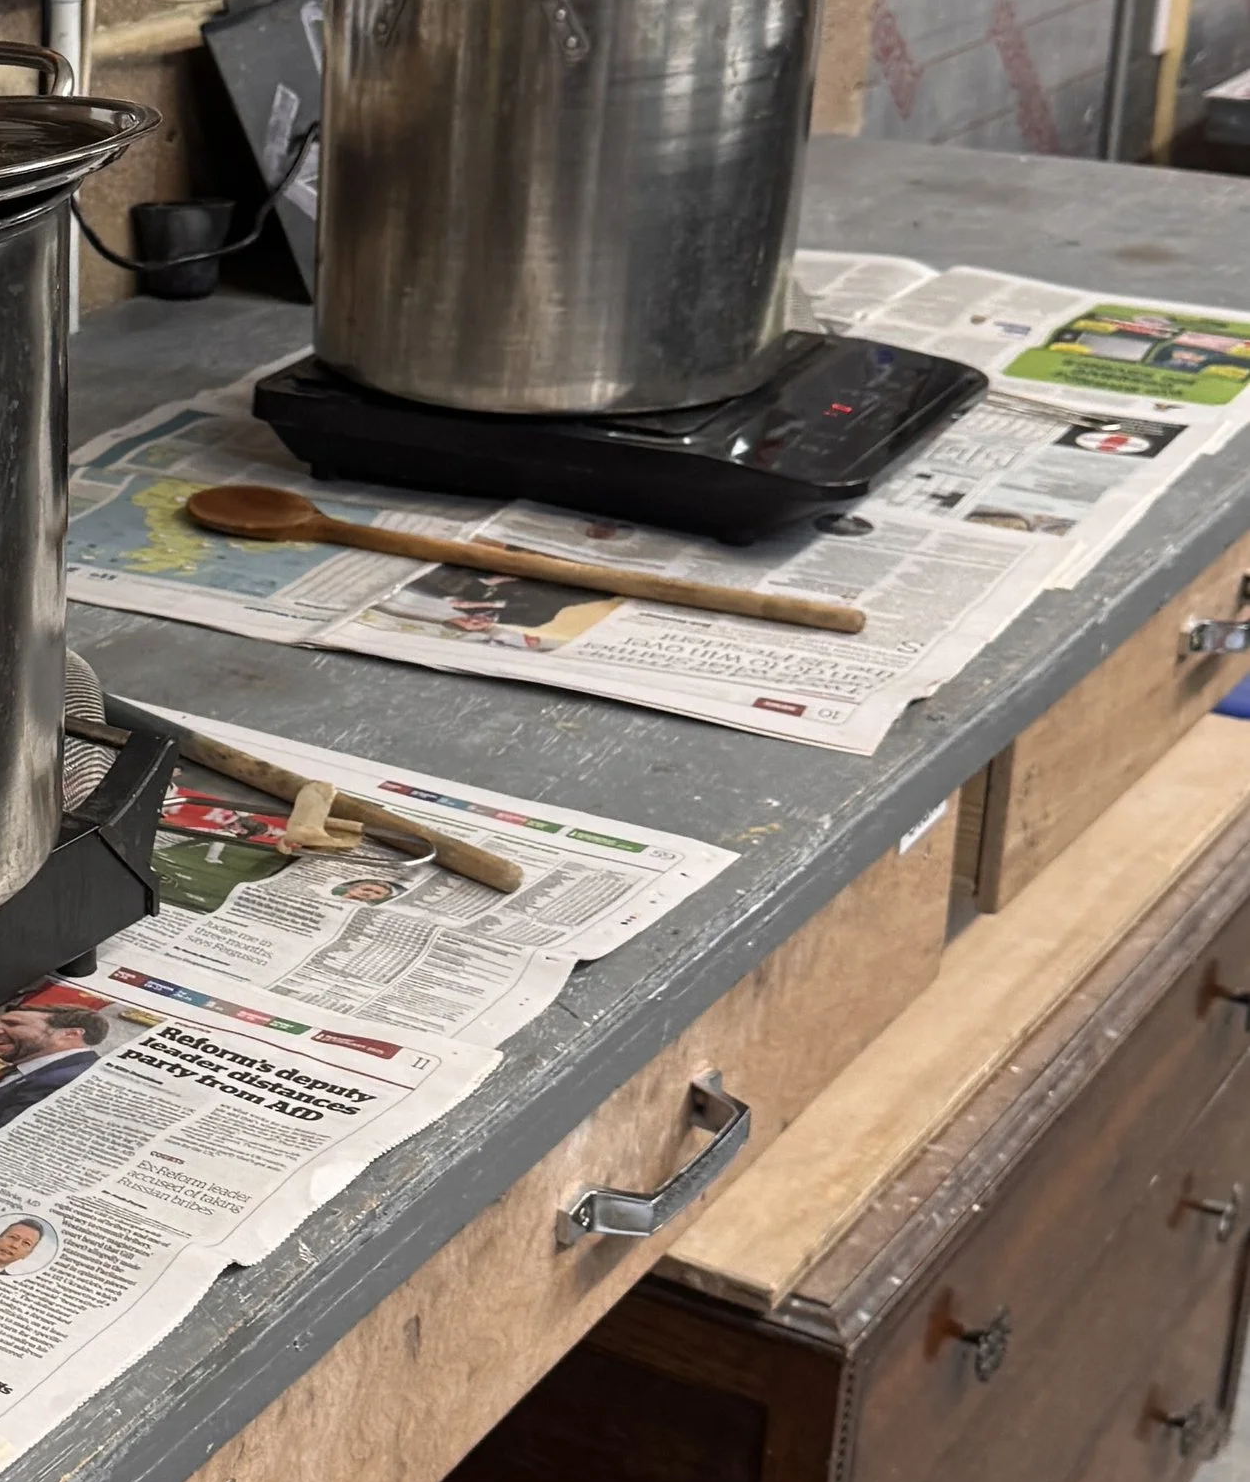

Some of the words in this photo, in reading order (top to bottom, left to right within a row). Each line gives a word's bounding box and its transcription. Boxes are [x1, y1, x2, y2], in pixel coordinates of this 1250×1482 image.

[194, 925, 227, 943] three
[210, 943, 269, 967] Ferguson
[117, 1047, 196, 1081] party
[198, 1072, 266, 1106] from
[264, 1097, 325, 1122] AfD
[139, 1037, 229, 1073] leader
[226, 1068, 362, 1117] distances
[156, 1025, 275, 1073] Reform's
[274, 1064, 378, 1104] deputy
[117, 1176, 172, 1202] Russian
[170, 1193, 216, 1217] bribes
[127, 1170, 185, 1198] accused
[199, 1191, 245, 1215] taking
[206, 1181, 254, 1204] leader
